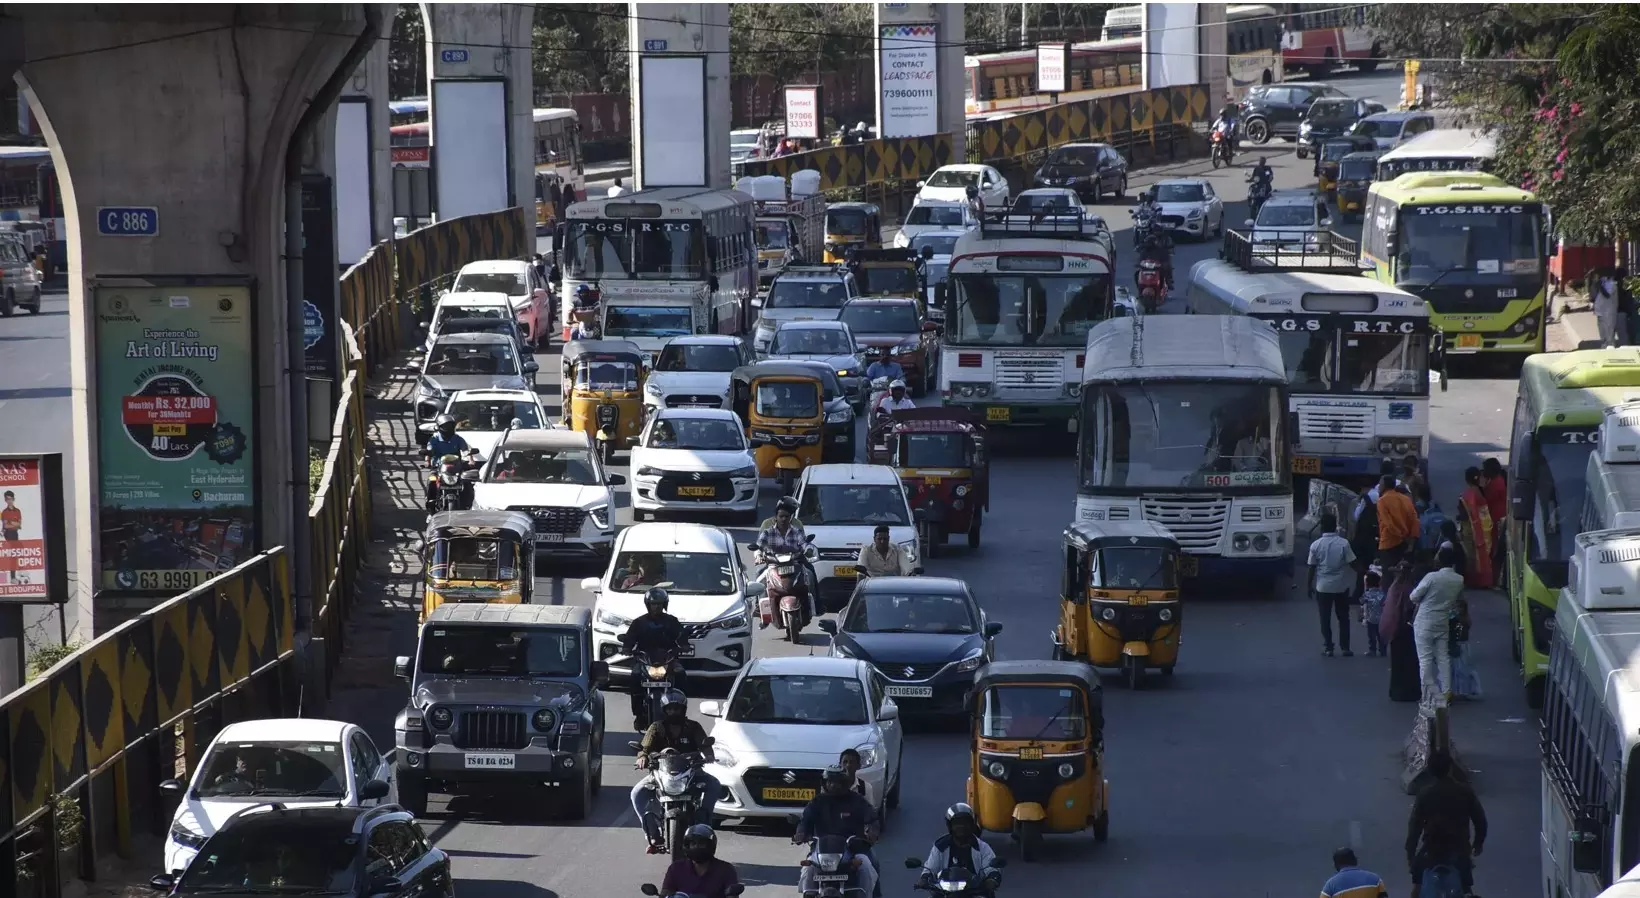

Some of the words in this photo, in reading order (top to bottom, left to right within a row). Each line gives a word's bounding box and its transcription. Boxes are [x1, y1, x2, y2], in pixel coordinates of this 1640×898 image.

[892, 61, 924, 69] CONTACT
[884, 71, 934, 81] LEADSPACE
[884, 89, 933, 98] 7396001111
[1416, 205, 1523, 215] T.G.S.R.T.C
[107, 212, 118, 231] C
[123, 212, 148, 231] 886
[1068, 260, 1088, 268] HNK
[144, 329, 185, 340] Experience
[186, 329, 199, 338] the
[126, 341, 150, 358] Art
[154, 341, 167, 358] of
[171, 341, 218, 361] Living
[128, 402, 155, 410] Monthly
[155, 397, 172, 409] Rs.
[147, 410, 159, 418] for
[170, 442, 190, 451] Lacs
[190, 475, 206, 484] East
[207, 475, 245, 485] Hyderabad
[1207, 475, 1231, 487] 500
[18, 557, 42, 567] OPEN
[139, 571, 158, 589] 63
[163, 571, 198, 589] 9991
[8, 584, 45, 594] BODUPPAL
[766, 789, 816, 799] TS08UK1411
